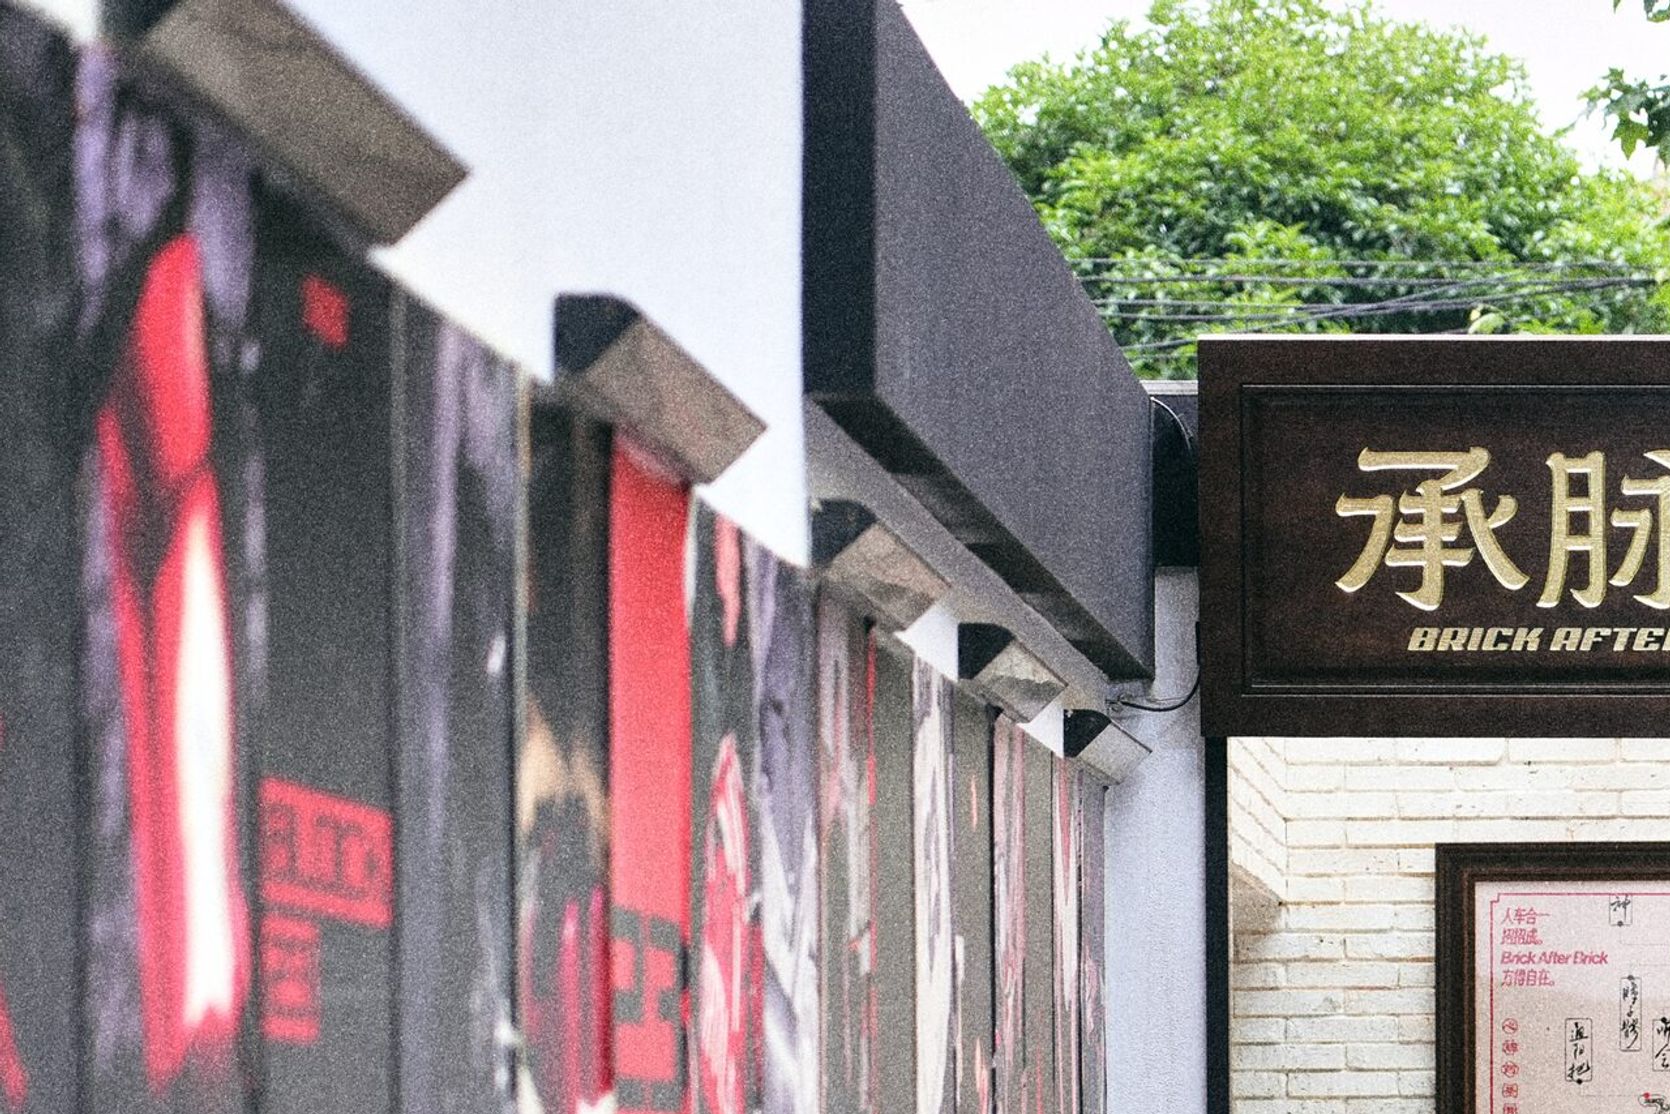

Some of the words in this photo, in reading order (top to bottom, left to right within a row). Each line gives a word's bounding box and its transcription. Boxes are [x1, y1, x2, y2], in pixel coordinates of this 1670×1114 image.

[1406, 627, 1544, 652] BRICK
[1501, 906, 1550, 926] 人车合一
[1501, 951, 1536, 965] Brick
[1538, 951, 1571, 965] After
[1572, 951, 1609, 965] Brick
